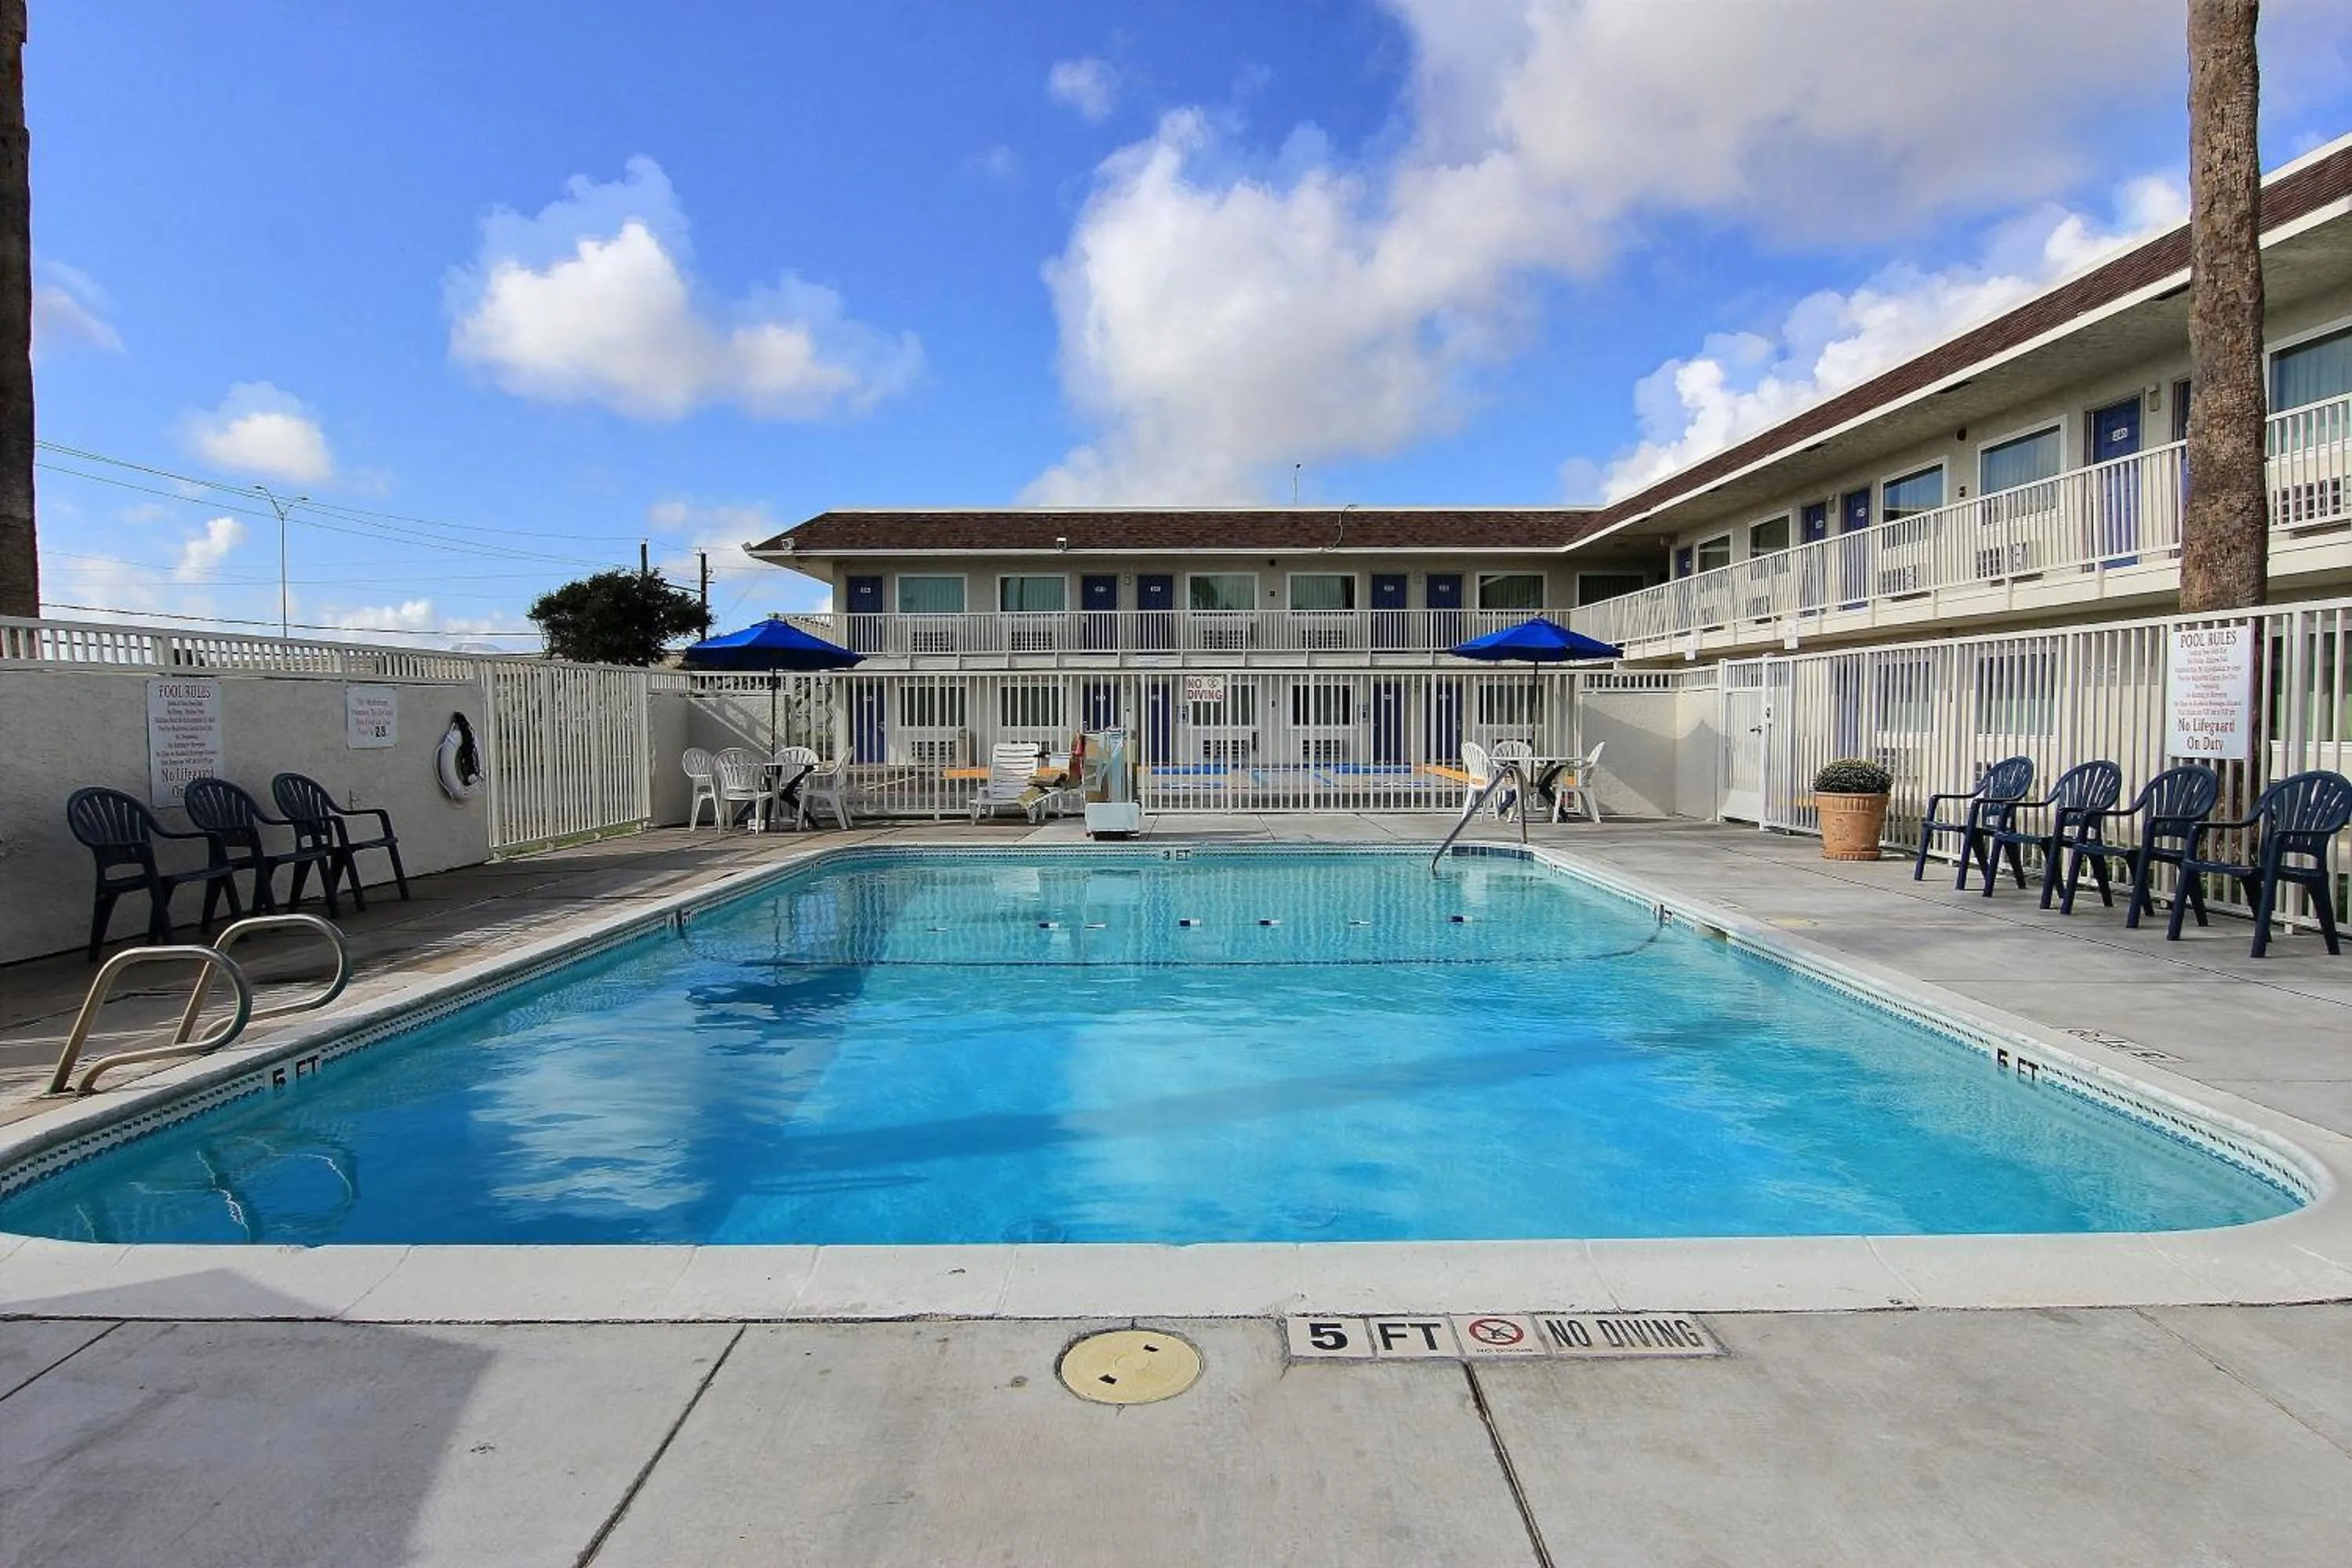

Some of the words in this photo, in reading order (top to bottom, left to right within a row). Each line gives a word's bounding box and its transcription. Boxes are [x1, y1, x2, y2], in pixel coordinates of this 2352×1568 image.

[2180, 633, 2205, 648] POOL
[2208, 630, 2237, 648] RULES
[158, 684, 183, 698] POOL
[184, 684, 211, 698] RULES
[1188, 678, 1202, 688] NO
[1188, 689, 1222, 700] DIVING
[2178, 717, 2190, 731] No
[2193, 717, 2235, 735] Lifeguard
[2187, 736, 2201, 750] On
[2203, 736, 2223, 751] Duty
[162, 768, 174, 782] No
[296, 1054, 318, 1079] FT
[2017, 1056, 2038, 1081] FT
[1308, 1323, 1348, 1351] 5
[1377, 1323, 1442, 1351] FT
[1545, 1319, 1593, 1348] NO
[1596, 1319, 1704, 1348] DIVING
